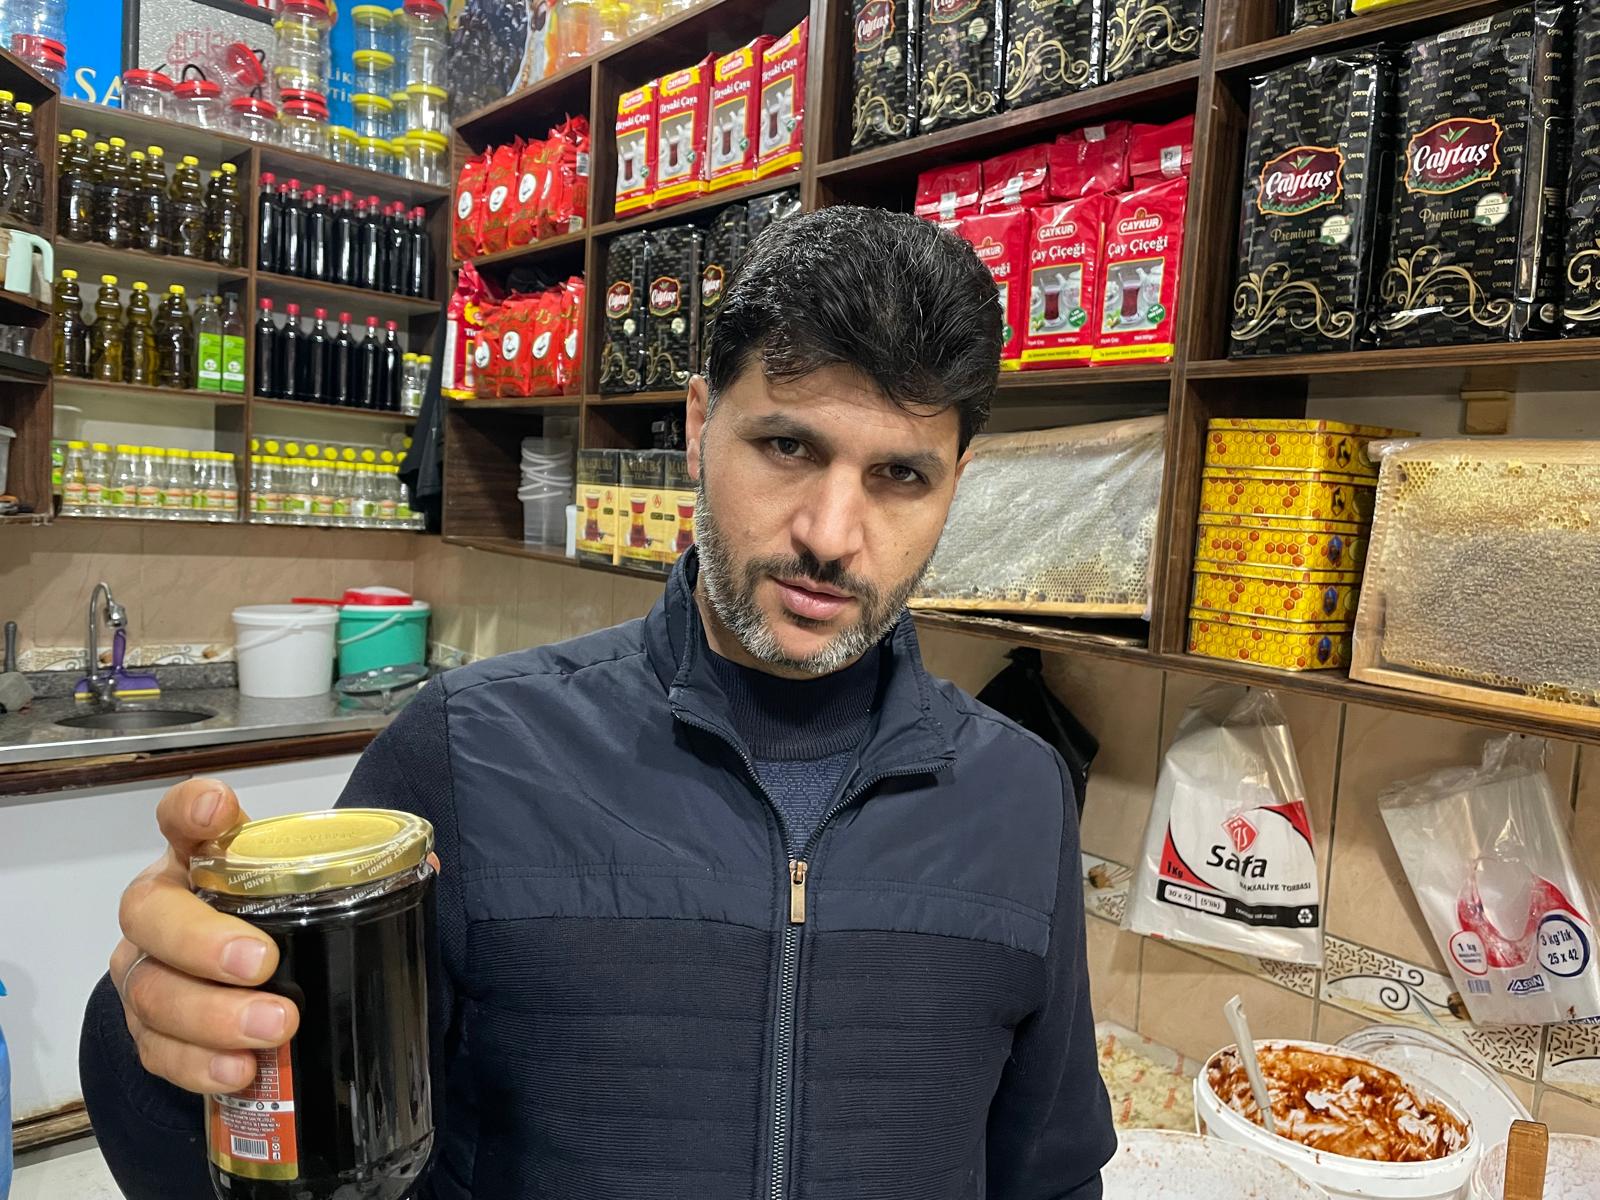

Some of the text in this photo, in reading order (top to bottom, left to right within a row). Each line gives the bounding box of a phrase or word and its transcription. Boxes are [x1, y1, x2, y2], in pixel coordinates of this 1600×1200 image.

[1413, 141, 1491, 177] Çaytaş
[1265, 170, 1334, 199] Çaytaş
[1418, 207, 1469, 224] Premium
[1483, 206, 1500, 214] 2002
[1270, 228, 1316, 242] Premium
[1048, 242, 1086, 260] Çiçeği
[1108, 236, 1168, 258] Çay Çiçeği
[367, 856, 393, 877] BANDI
[1206, 844, 1267, 879] Safa
[243, 874, 271, 890] BANDI
[1457, 943, 1464, 952] 1
[1540, 934, 1547, 946] 3
[1547, 948, 1580, 965] 25 x 42
